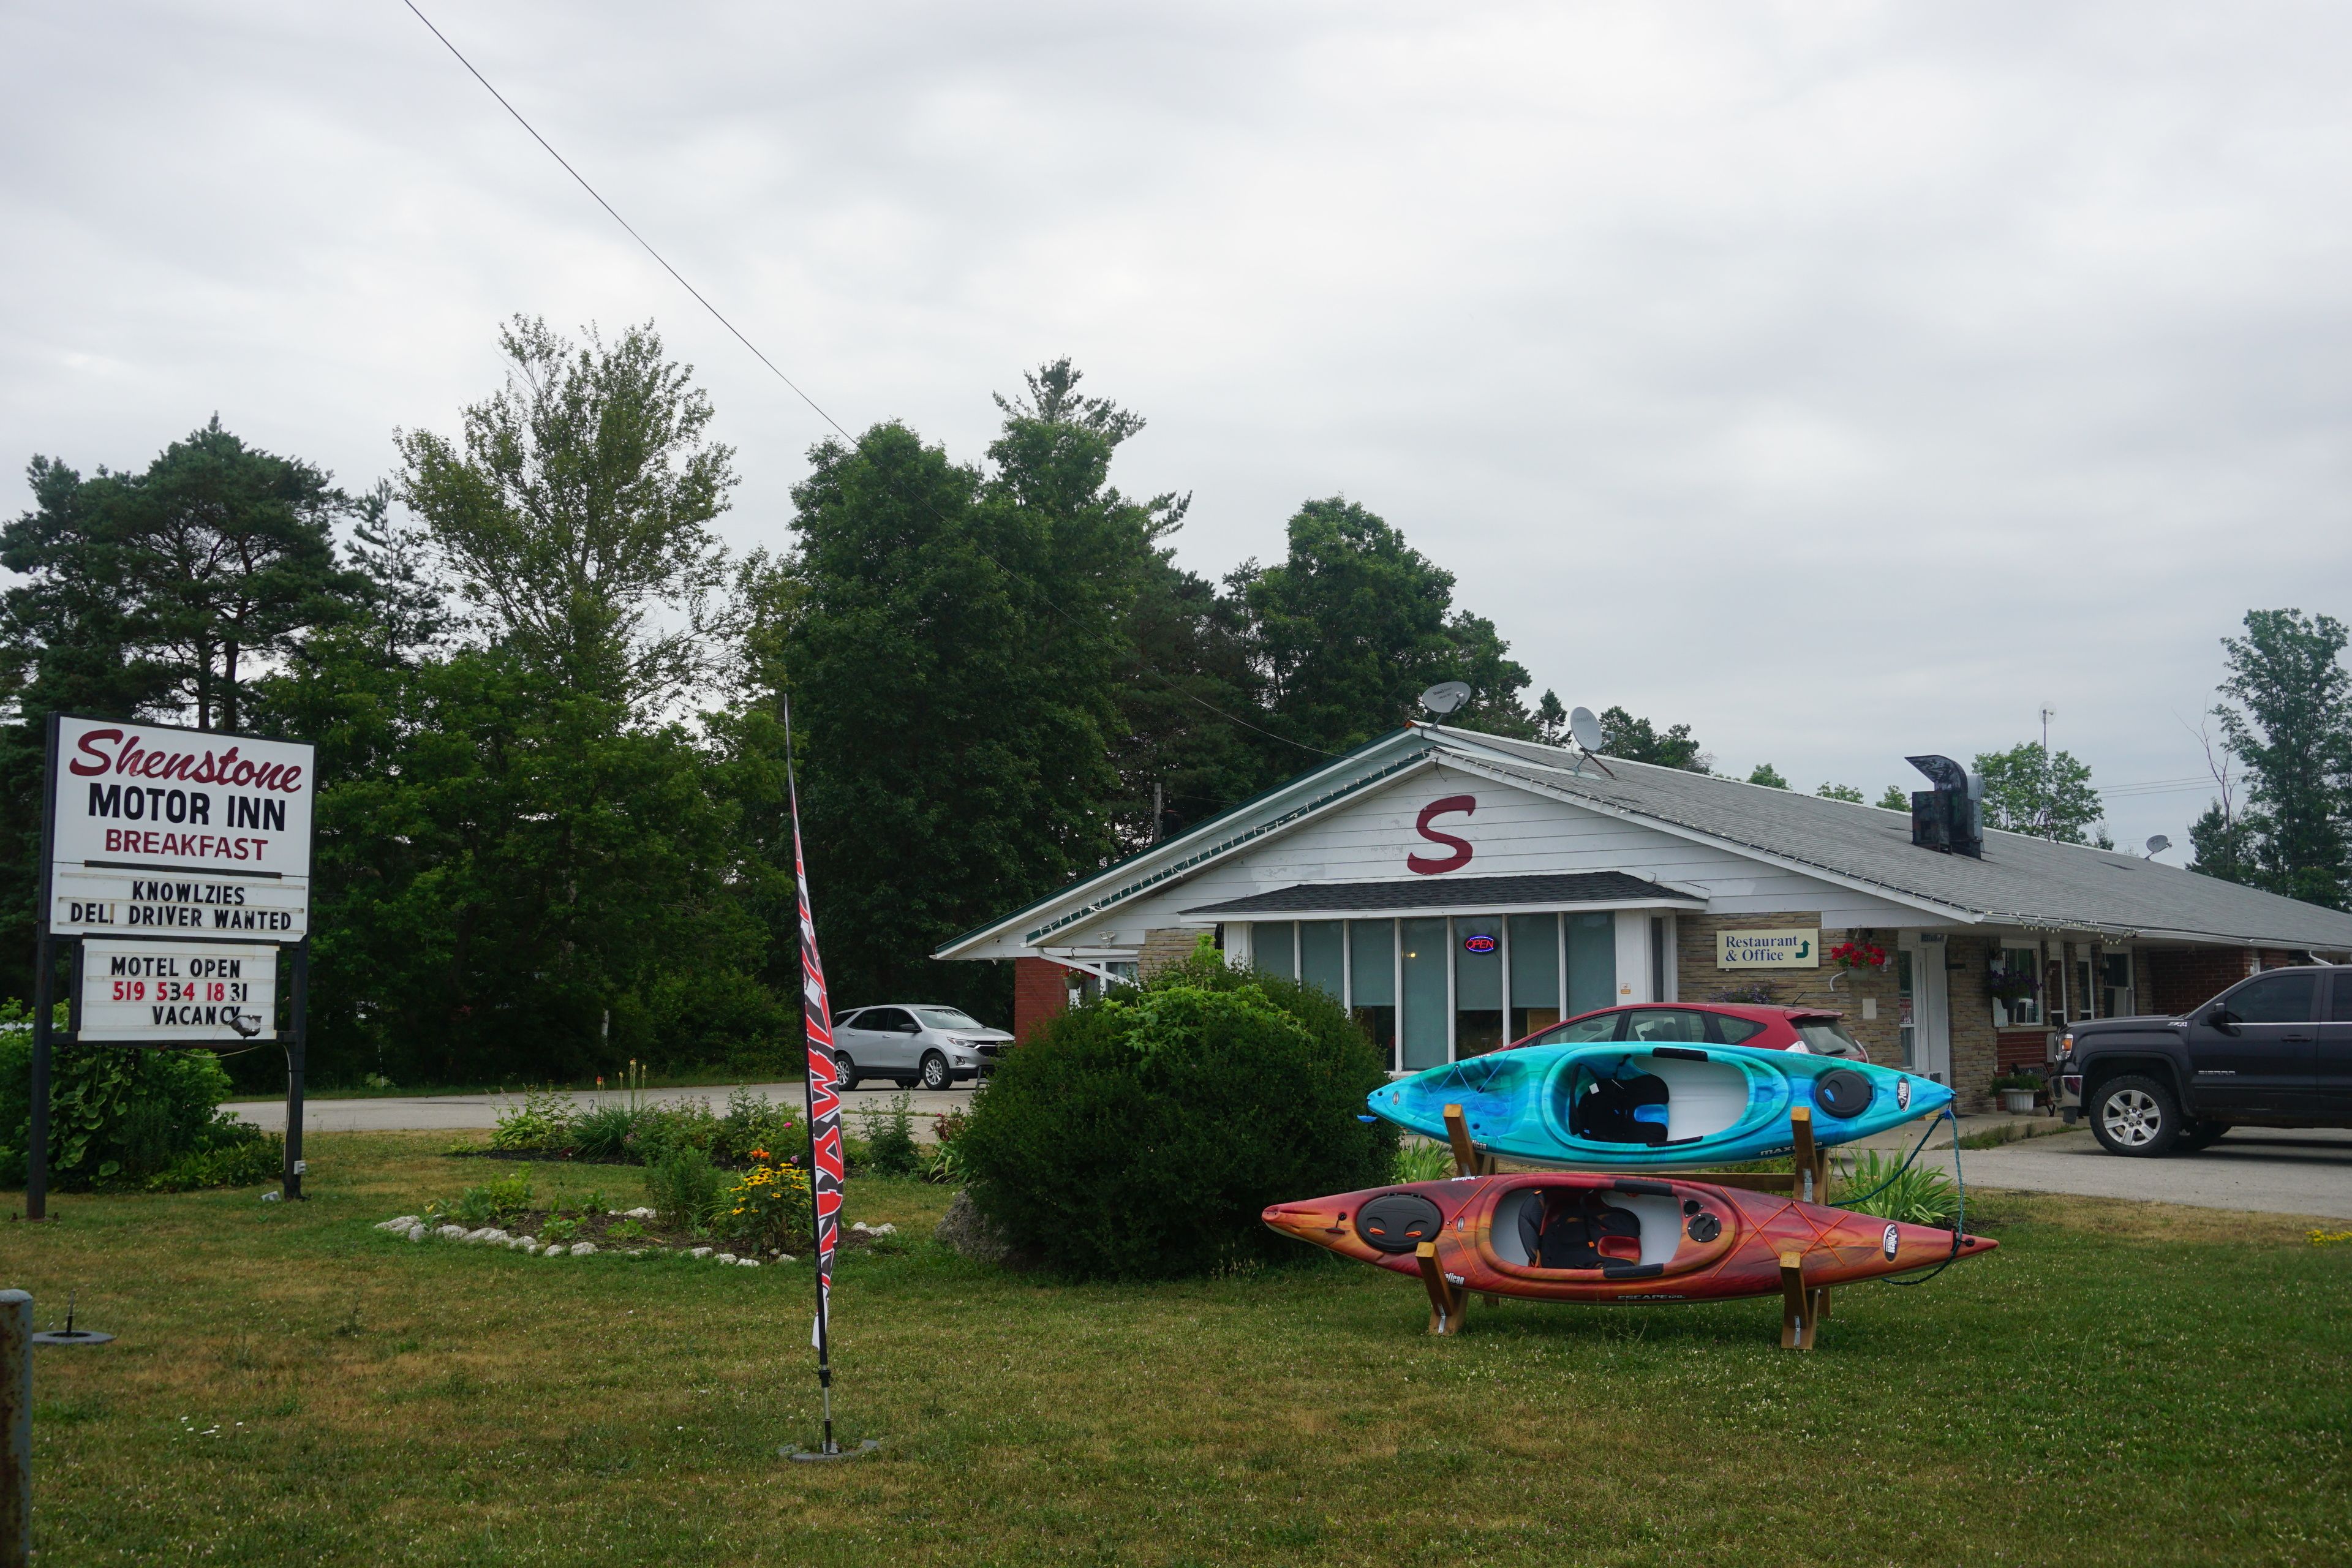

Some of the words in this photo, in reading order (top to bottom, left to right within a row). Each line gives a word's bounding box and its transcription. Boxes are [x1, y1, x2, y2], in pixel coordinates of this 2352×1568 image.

[69, 729, 301, 793] Shenstone
[88, 783, 210, 826] MOTOR
[227, 795, 285, 832] INN
[105, 829, 268, 861] BREAKFAST
[1407, 795, 1476, 875] S
[132, 881, 245, 906] KNOWLZIES
[129, 905, 202, 927] DRIVER
[214, 910, 291, 930] WANTED
[1466, 939, 1494, 949] OPEN
[1725, 935, 1798, 948] Restaurant
[111, 956, 179, 976] MOTEL
[190, 959, 241, 978] OPEN
[1725, 949, 1738, 962] &
[1742, 949, 1784, 962] Office
[113, 981, 145, 1001] 519
[157, 981, 195, 1001] 534
[207, 982, 247, 1001] 1831
[1445, 1272, 1464, 1285] elican
